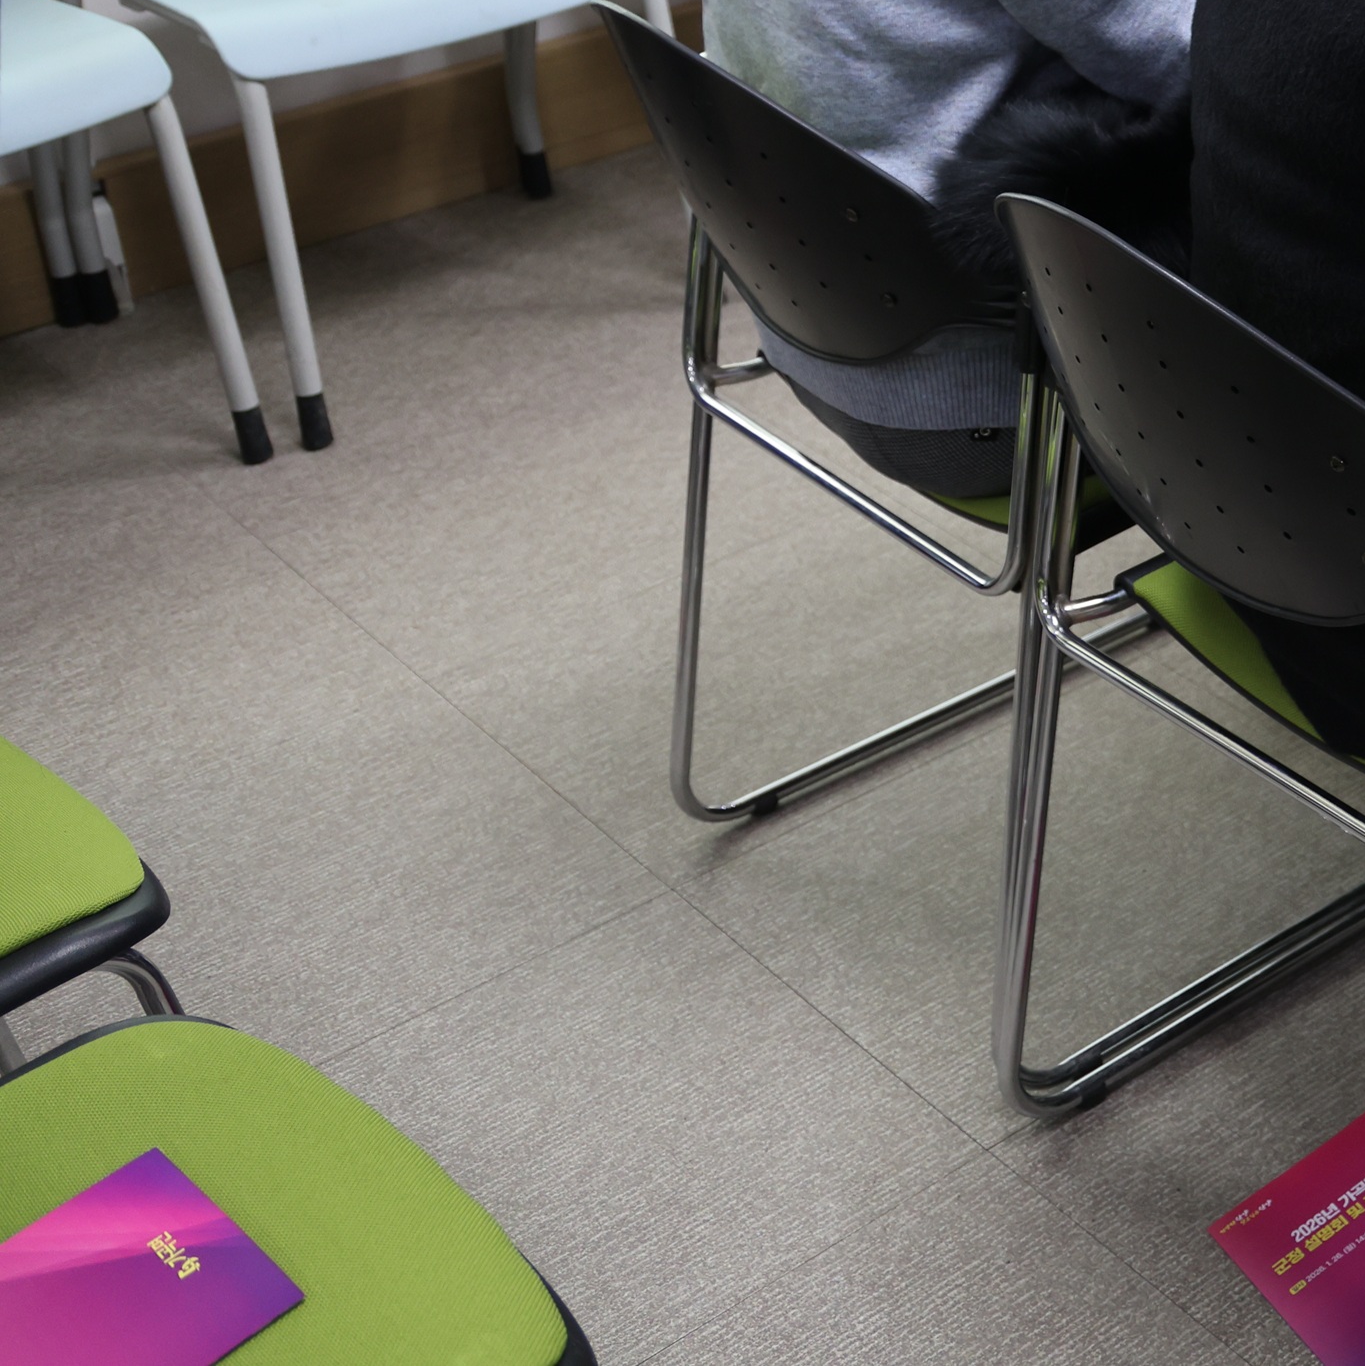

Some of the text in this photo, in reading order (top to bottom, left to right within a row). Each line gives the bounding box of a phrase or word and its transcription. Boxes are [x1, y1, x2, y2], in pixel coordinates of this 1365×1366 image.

[1290, 1202, 1342, 1243] 2026년
[147, 1230, 186, 1269] 가곡면
[1271, 1247, 1306, 1276] 군정
[1304, 1214, 1350, 1252] 설명회
